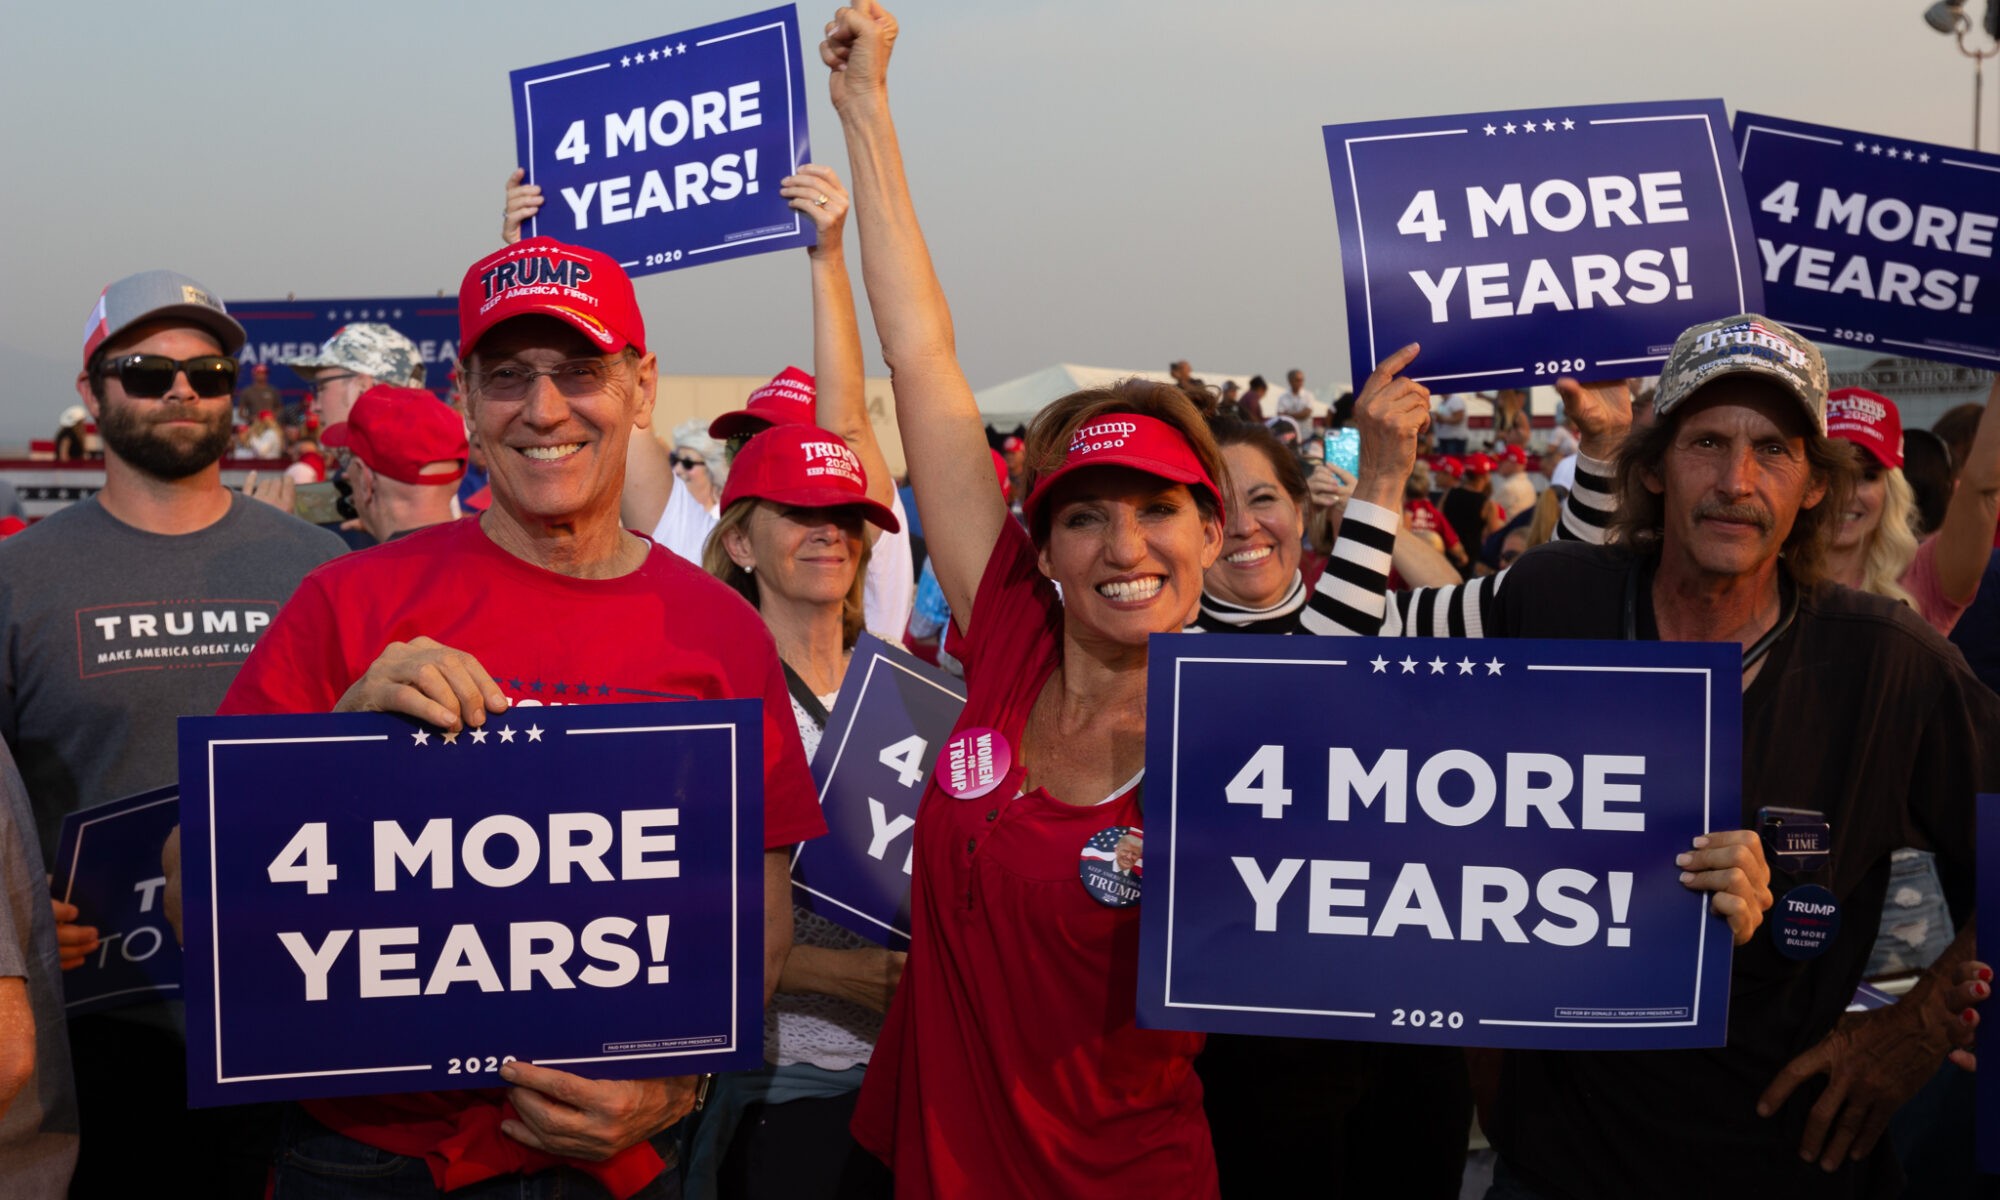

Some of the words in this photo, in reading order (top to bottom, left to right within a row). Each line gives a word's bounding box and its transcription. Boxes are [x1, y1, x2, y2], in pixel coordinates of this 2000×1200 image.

[556, 119, 590, 165] 4
[605, 80, 762, 158] MORE
[561, 148, 759, 230] YEARS!
[1397, 189, 1446, 242] 4
[1465, 170, 1690, 237] MORE
[1761, 180, 1800, 224] 4
[1814, 187, 1999, 258] MORE
[646, 250, 682, 266] 2020
[480, 257, 592, 302] TRUMP
[1409, 246, 1694, 323] YEARS!
[1758, 238, 1980, 314] YEARS!
[480, 295, 502, 315] KEEP
[505, 286, 559, 299] AMERICA
[563, 288, 598, 307] FIRST!
[1696, 329, 1806, 368] Trump
[1833, 328, 1875, 343] 2020
[238, 341, 324, 365] AMER
[1534, 358, 1586, 375] 2020
[775, 389, 813, 405] AGAIN
[1071, 421, 1137, 446] Trump
[1082, 439, 1124, 454] 2020
[800, 442, 860, 473] TRUMP
[825, 457, 852, 471] 2020
[95, 610, 270, 641] TRUMP
[98, 649, 133, 664] MAKE
[135, 646, 189, 658] AMERICA
[192, 643, 230, 656] GREAT
[879, 734, 928, 788] 4
[950, 738, 967, 791] TRUMP
[967, 755, 976, 769] FOR
[977, 733, 993, 785] WOMEN
[1225, 744, 1292, 819] 4
[1328, 747, 1646, 832] MORE
[267, 822, 338, 895] 4
[373, 808, 680, 891] MORE
[1786, 838, 1820, 850] TIME
[1088, 873, 1141, 901] TRUMP
[1231, 857, 1634, 947] YEARS!
[1787, 899, 1836, 916] TRUMP
[1784, 928, 1798, 937] NO
[1801, 929, 1827, 939] MORE
[1786, 938, 1820, 948] BULLSHIT
[277, 915, 670, 1001] YEARS!
[1392, 1008, 1464, 1029] 2020
